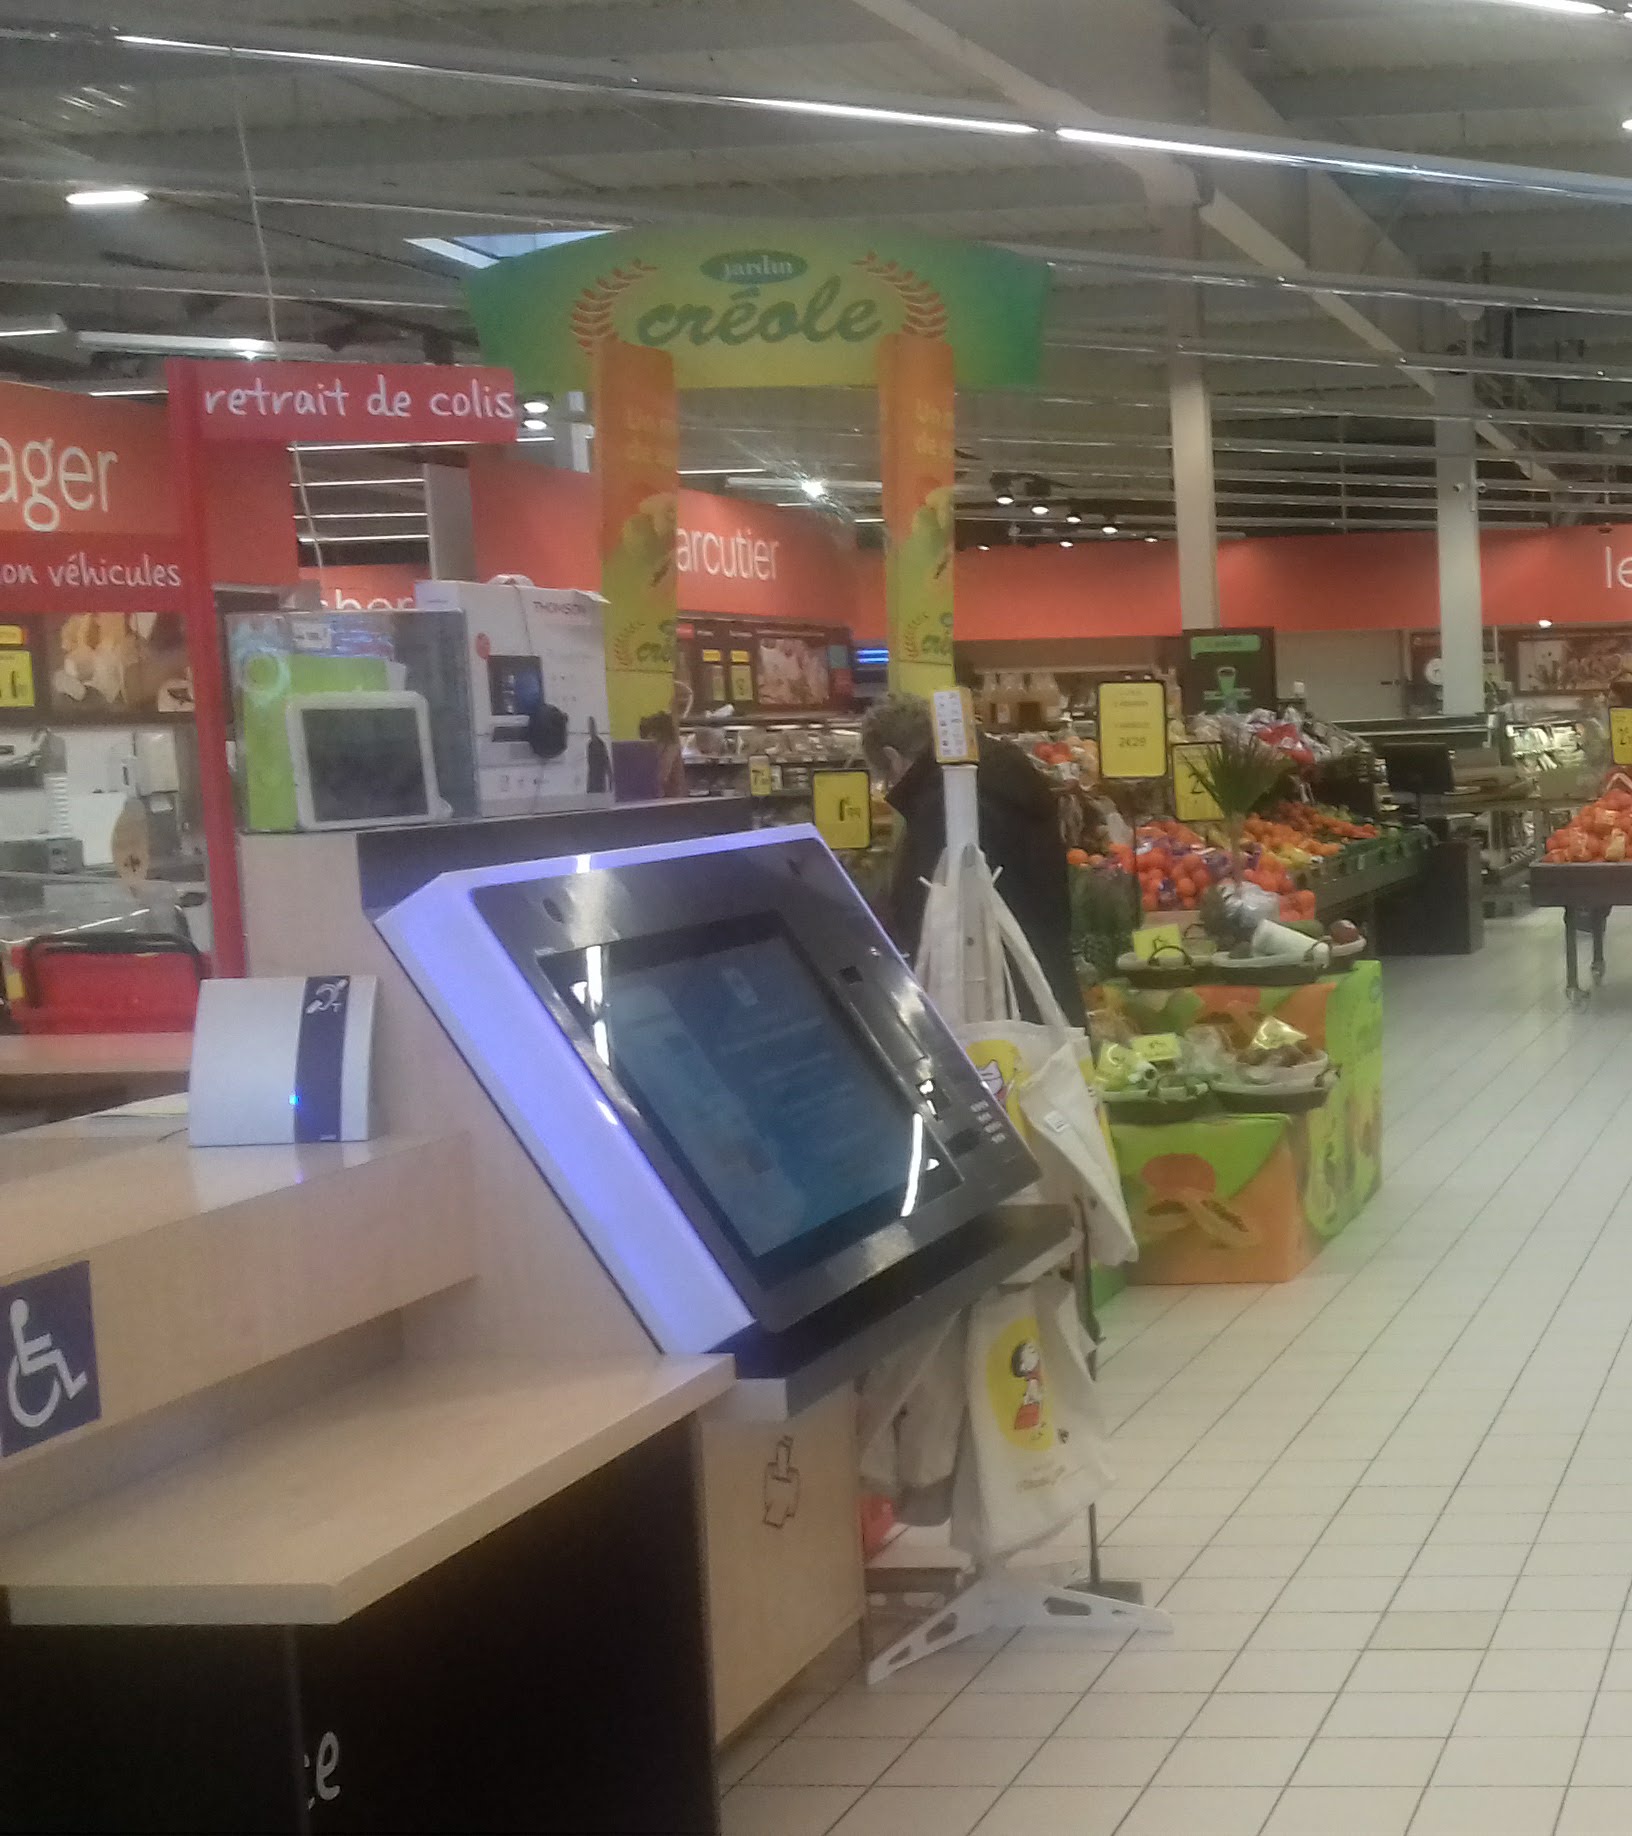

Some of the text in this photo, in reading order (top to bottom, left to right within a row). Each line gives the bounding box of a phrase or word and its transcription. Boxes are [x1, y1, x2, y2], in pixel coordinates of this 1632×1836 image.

[637, 275, 883, 346] créole
[204, 374, 516, 419] retrait de colis
[0, 436, 119, 532] ager
[48, 551, 182, 587] véhicules
[676, 526, 780, 581] arcutier
